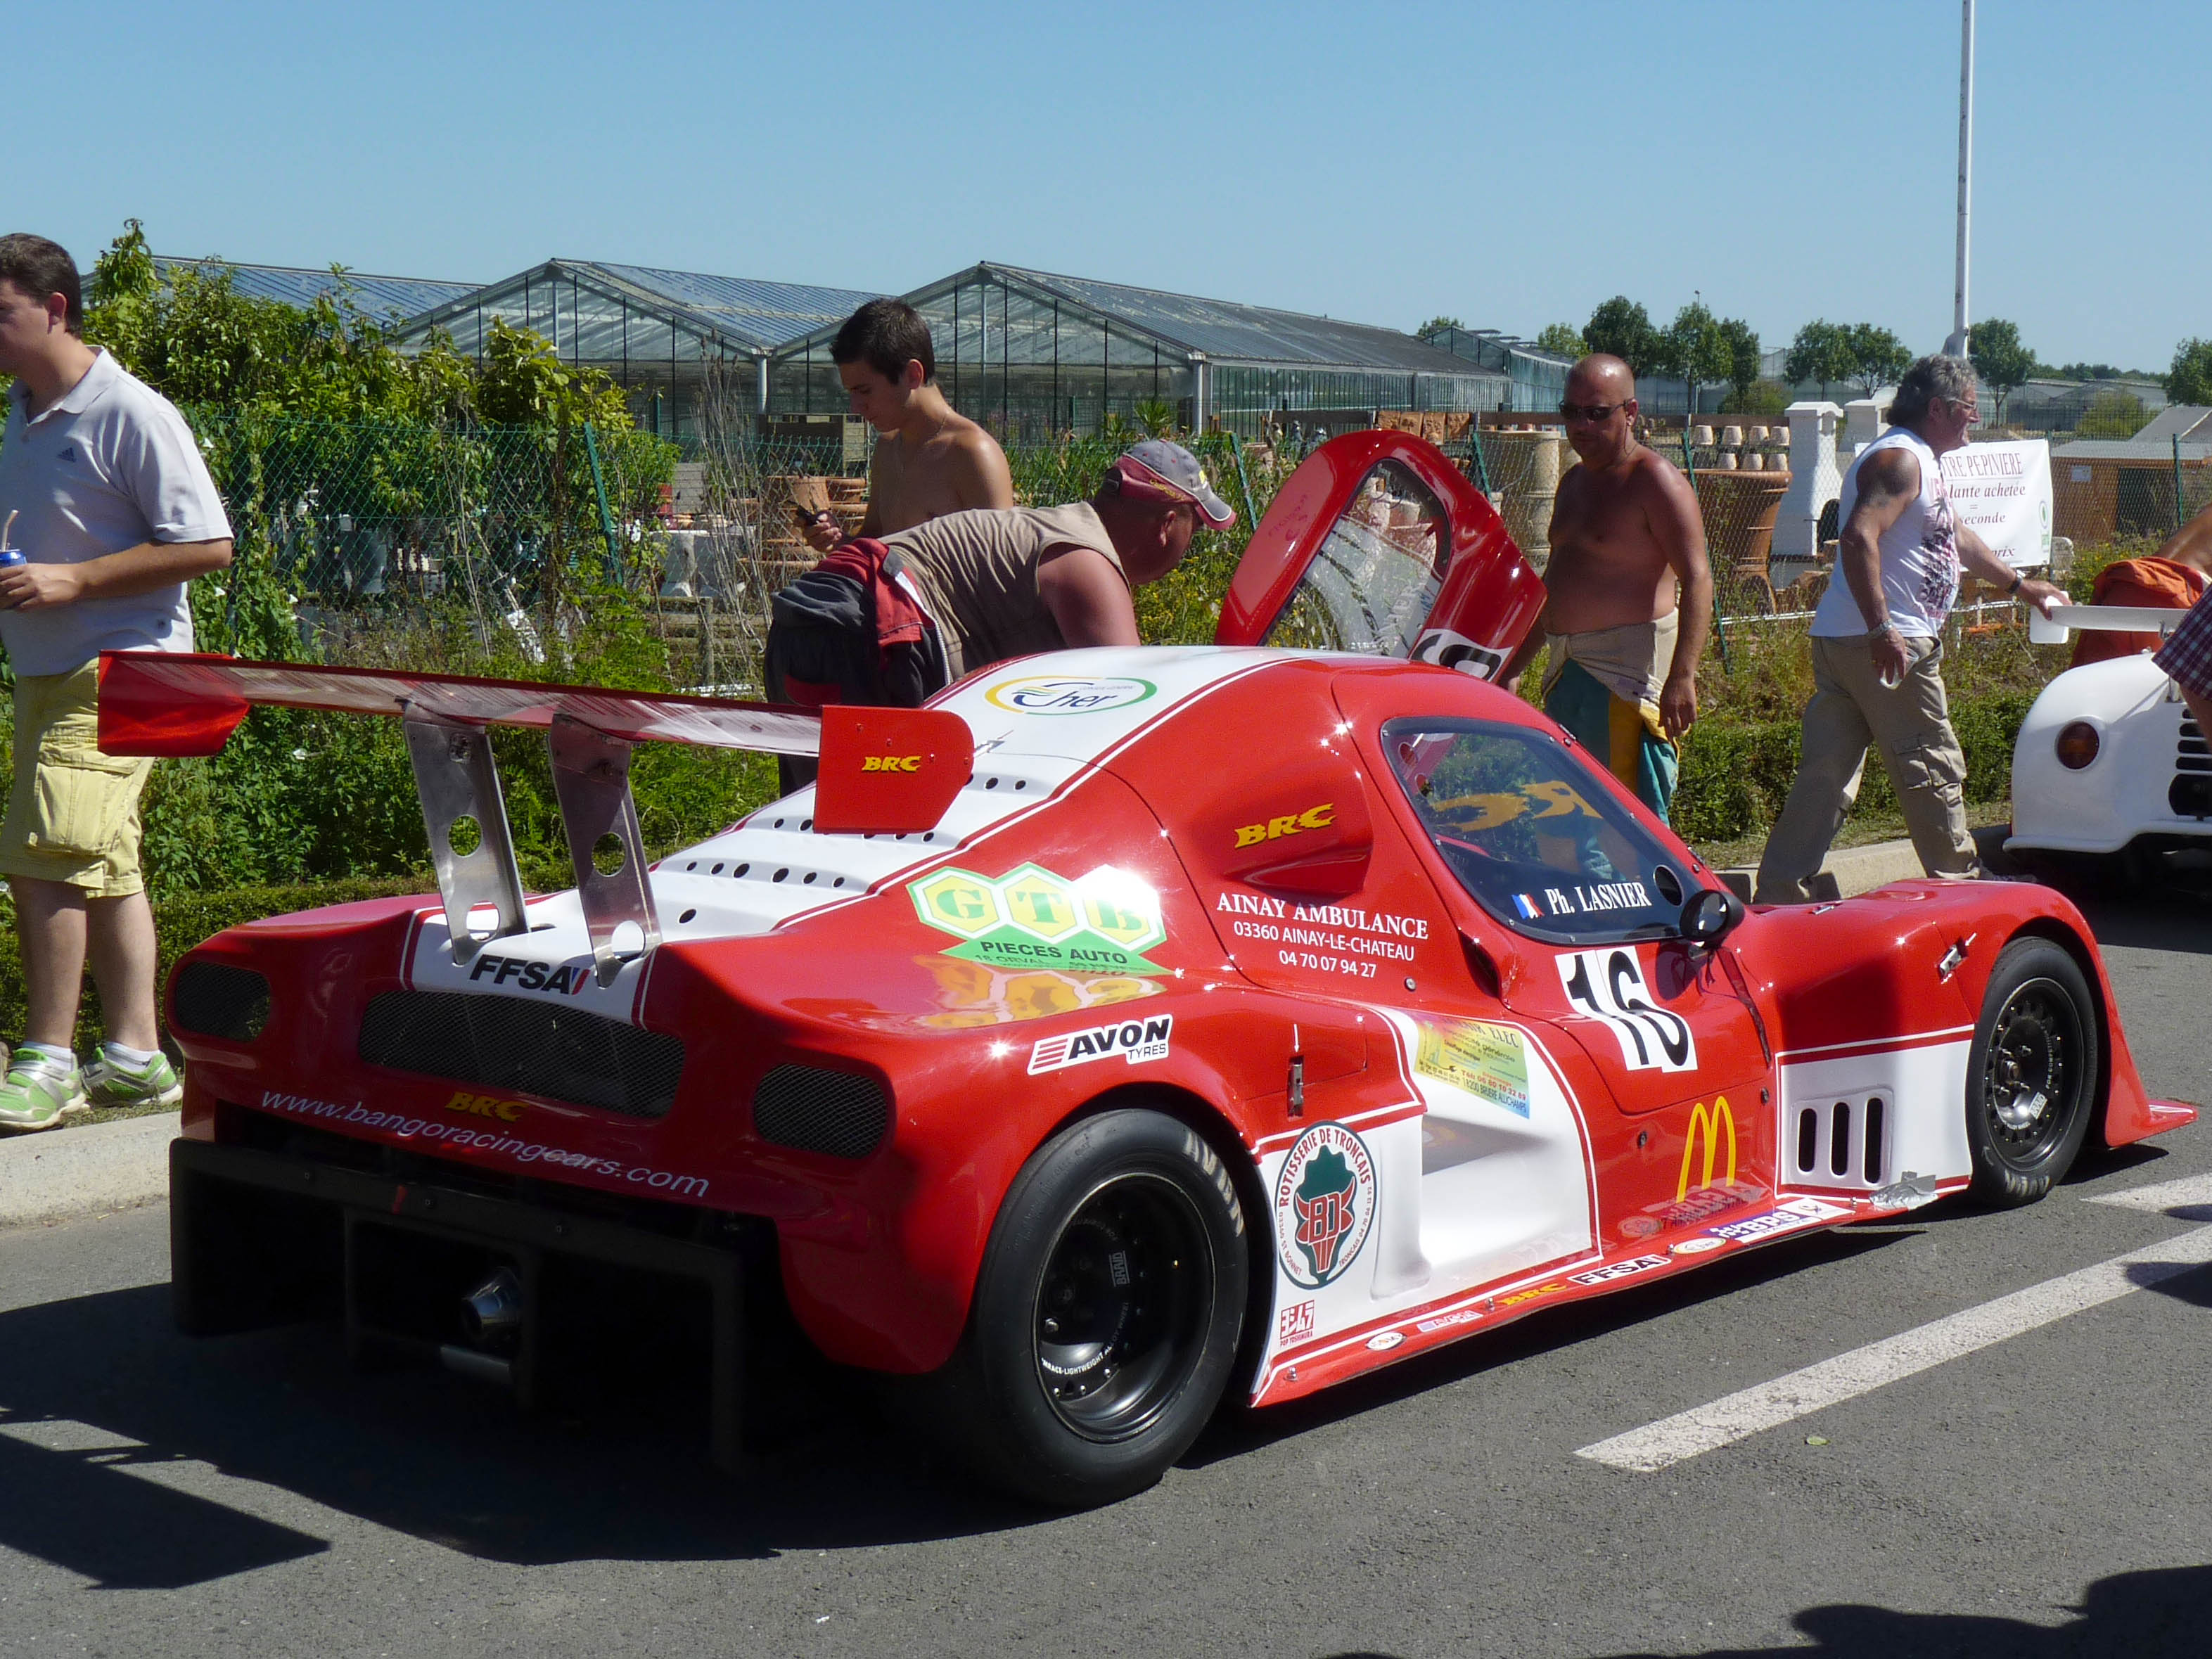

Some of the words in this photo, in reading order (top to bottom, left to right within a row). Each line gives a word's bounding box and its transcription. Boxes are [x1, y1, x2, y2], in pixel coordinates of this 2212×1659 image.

[1967, 452, 2023, 477] PEPINIERE
[1949, 483, 1981, 499] lante
[1983, 480, 2026, 499] achetée
[860, 755, 922, 772] BRC
[1234, 802, 1337, 848] BRC
[1545, 887, 1575, 915] Ph.
[1574, 881, 1652, 913] LASNIER
[1216, 892, 1286, 918] AINAY
[1293, 901, 1429, 940] AMBULANCE
[980, 941, 1062, 959] PIECES
[1070, 948, 1128, 964] AUTO
[1233, 921, 1279, 941] 03360
[1281, 926, 1415, 961] AINAY-LE-CHATEAU
[469, 954, 572, 994] FFSA
[1279, 950, 1298, 966] 04
[1299, 954, 1318, 969] 70
[1320, 956, 1338, 972] 07
[1340, 959, 1358, 975] 94
[1360, 962, 1377, 978] 27
[1566, 950, 1689, 1066] 16
[1068, 1018, 1170, 1060] AVON
[1127, 1043, 1167, 1060] TYRES
[444, 1091, 530, 1122] BRC
[1279, 1132, 1318, 1208] ROTISSERIE
[1318, 1127, 1331, 1144] DE
[1334, 1129, 1372, 1185] TRONÇAIS
[1737, 1211, 1801, 1233] BPS
[1573, 1258, 1658, 1284] FFSA
[1497, 1283, 1567, 1306] BRC
